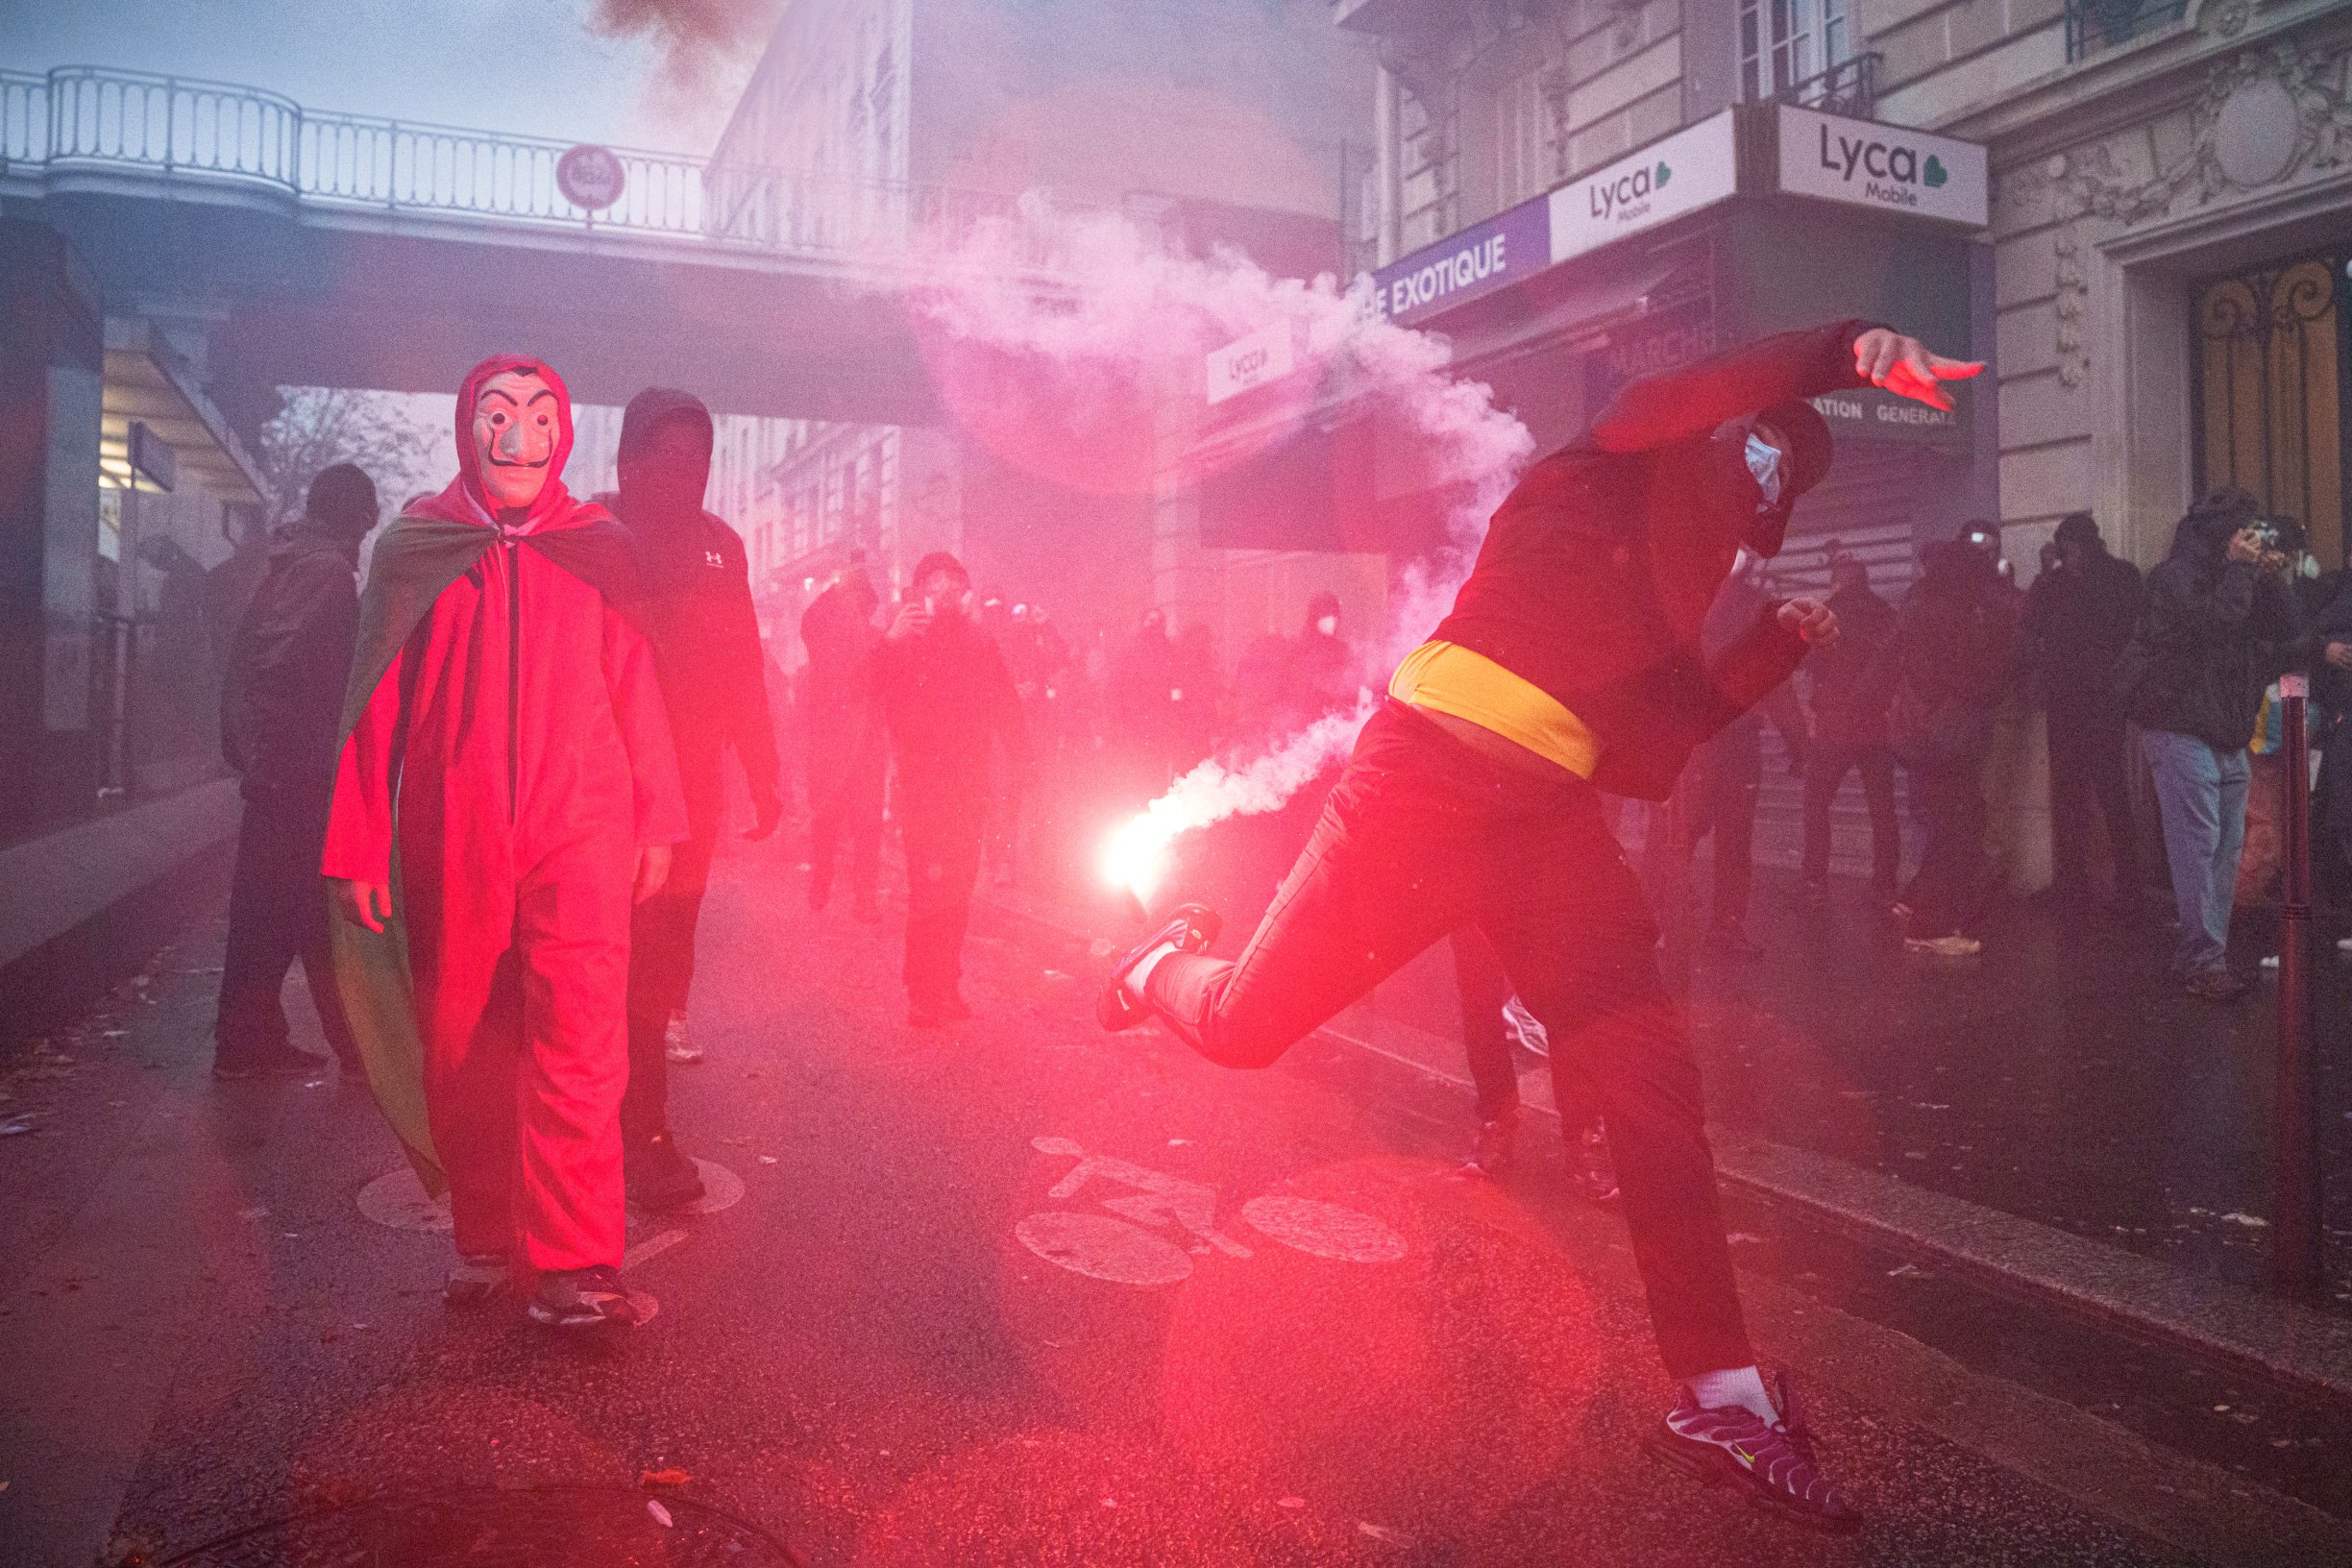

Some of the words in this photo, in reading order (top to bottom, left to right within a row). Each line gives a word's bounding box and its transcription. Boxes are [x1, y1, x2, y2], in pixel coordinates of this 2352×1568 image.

[1821, 123, 1918, 184] Lyca
[1589, 166, 1651, 220] Lyca
[1865, 182, 1918, 207] Mobile
[1392, 233, 1507, 315] EXOTIQUE
[1806, 397, 1863, 419] ATION
